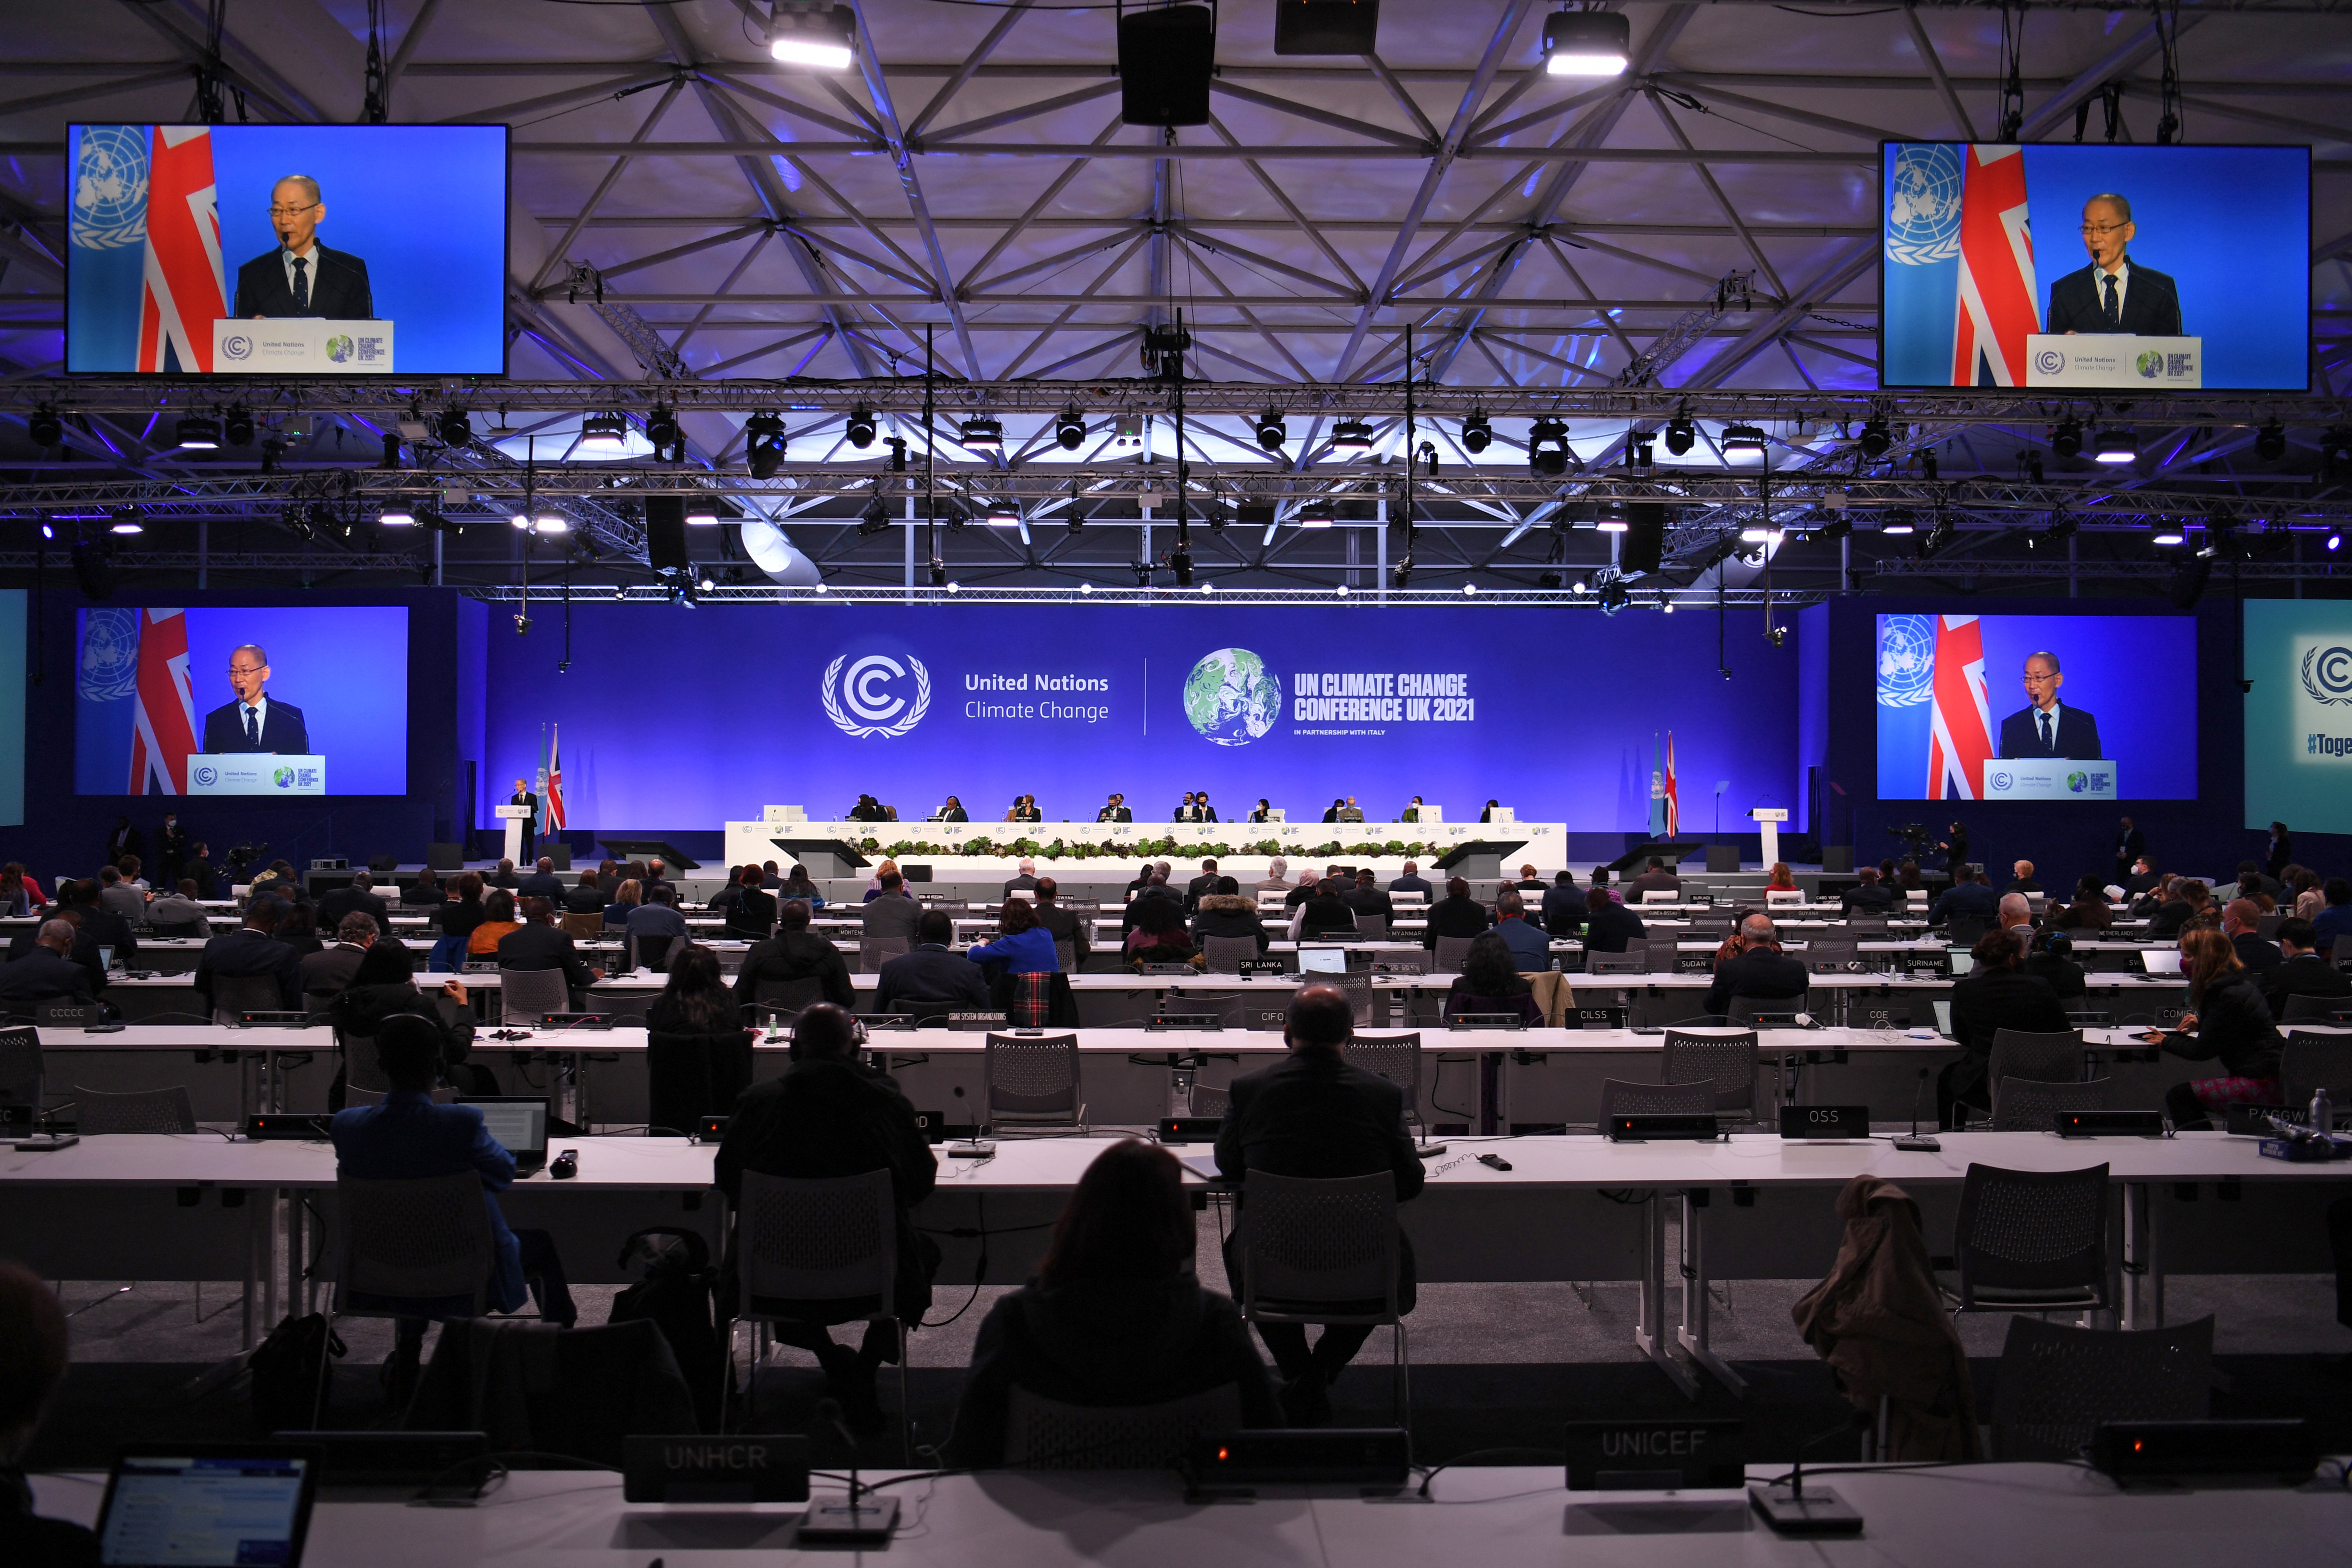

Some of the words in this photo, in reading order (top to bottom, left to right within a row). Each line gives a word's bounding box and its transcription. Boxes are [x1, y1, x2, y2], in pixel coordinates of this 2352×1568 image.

[966, 674, 1027, 691] United
[1035, 674, 1108, 691] Nations
[1294, 673, 1318, 696] UN
[1322, 673, 1394, 696] CLIMATE
[1398, 674, 1467, 697] CHANGE
[966, 701, 1034, 718] Climate
[1040, 701, 1108, 723] Change
[1294, 698, 1402, 721] CONFERENCE
[1406, 698, 1430, 721] UK
[1433, 698, 1474, 721] 2021
[2308, 734, 2352, 757] #Toge
[50, 1008, 84, 1017] CCCCC
[949, 1012, 960, 1020] CGIAR
[961, 1012, 977, 1020] SYSTEM
[977, 1012, 1007, 1020] ORGANIZATIONS
[1580, 1010, 1607, 1019] CILSS
[1870, 1010, 1888, 1019] COE
[1809, 1111, 1839, 1122] OSS
[2249, 1108, 2305, 1122] PAGGW
[1602, 1430, 1707, 1456] UNICEF
[664, 1445, 768, 1469] UNHCR
